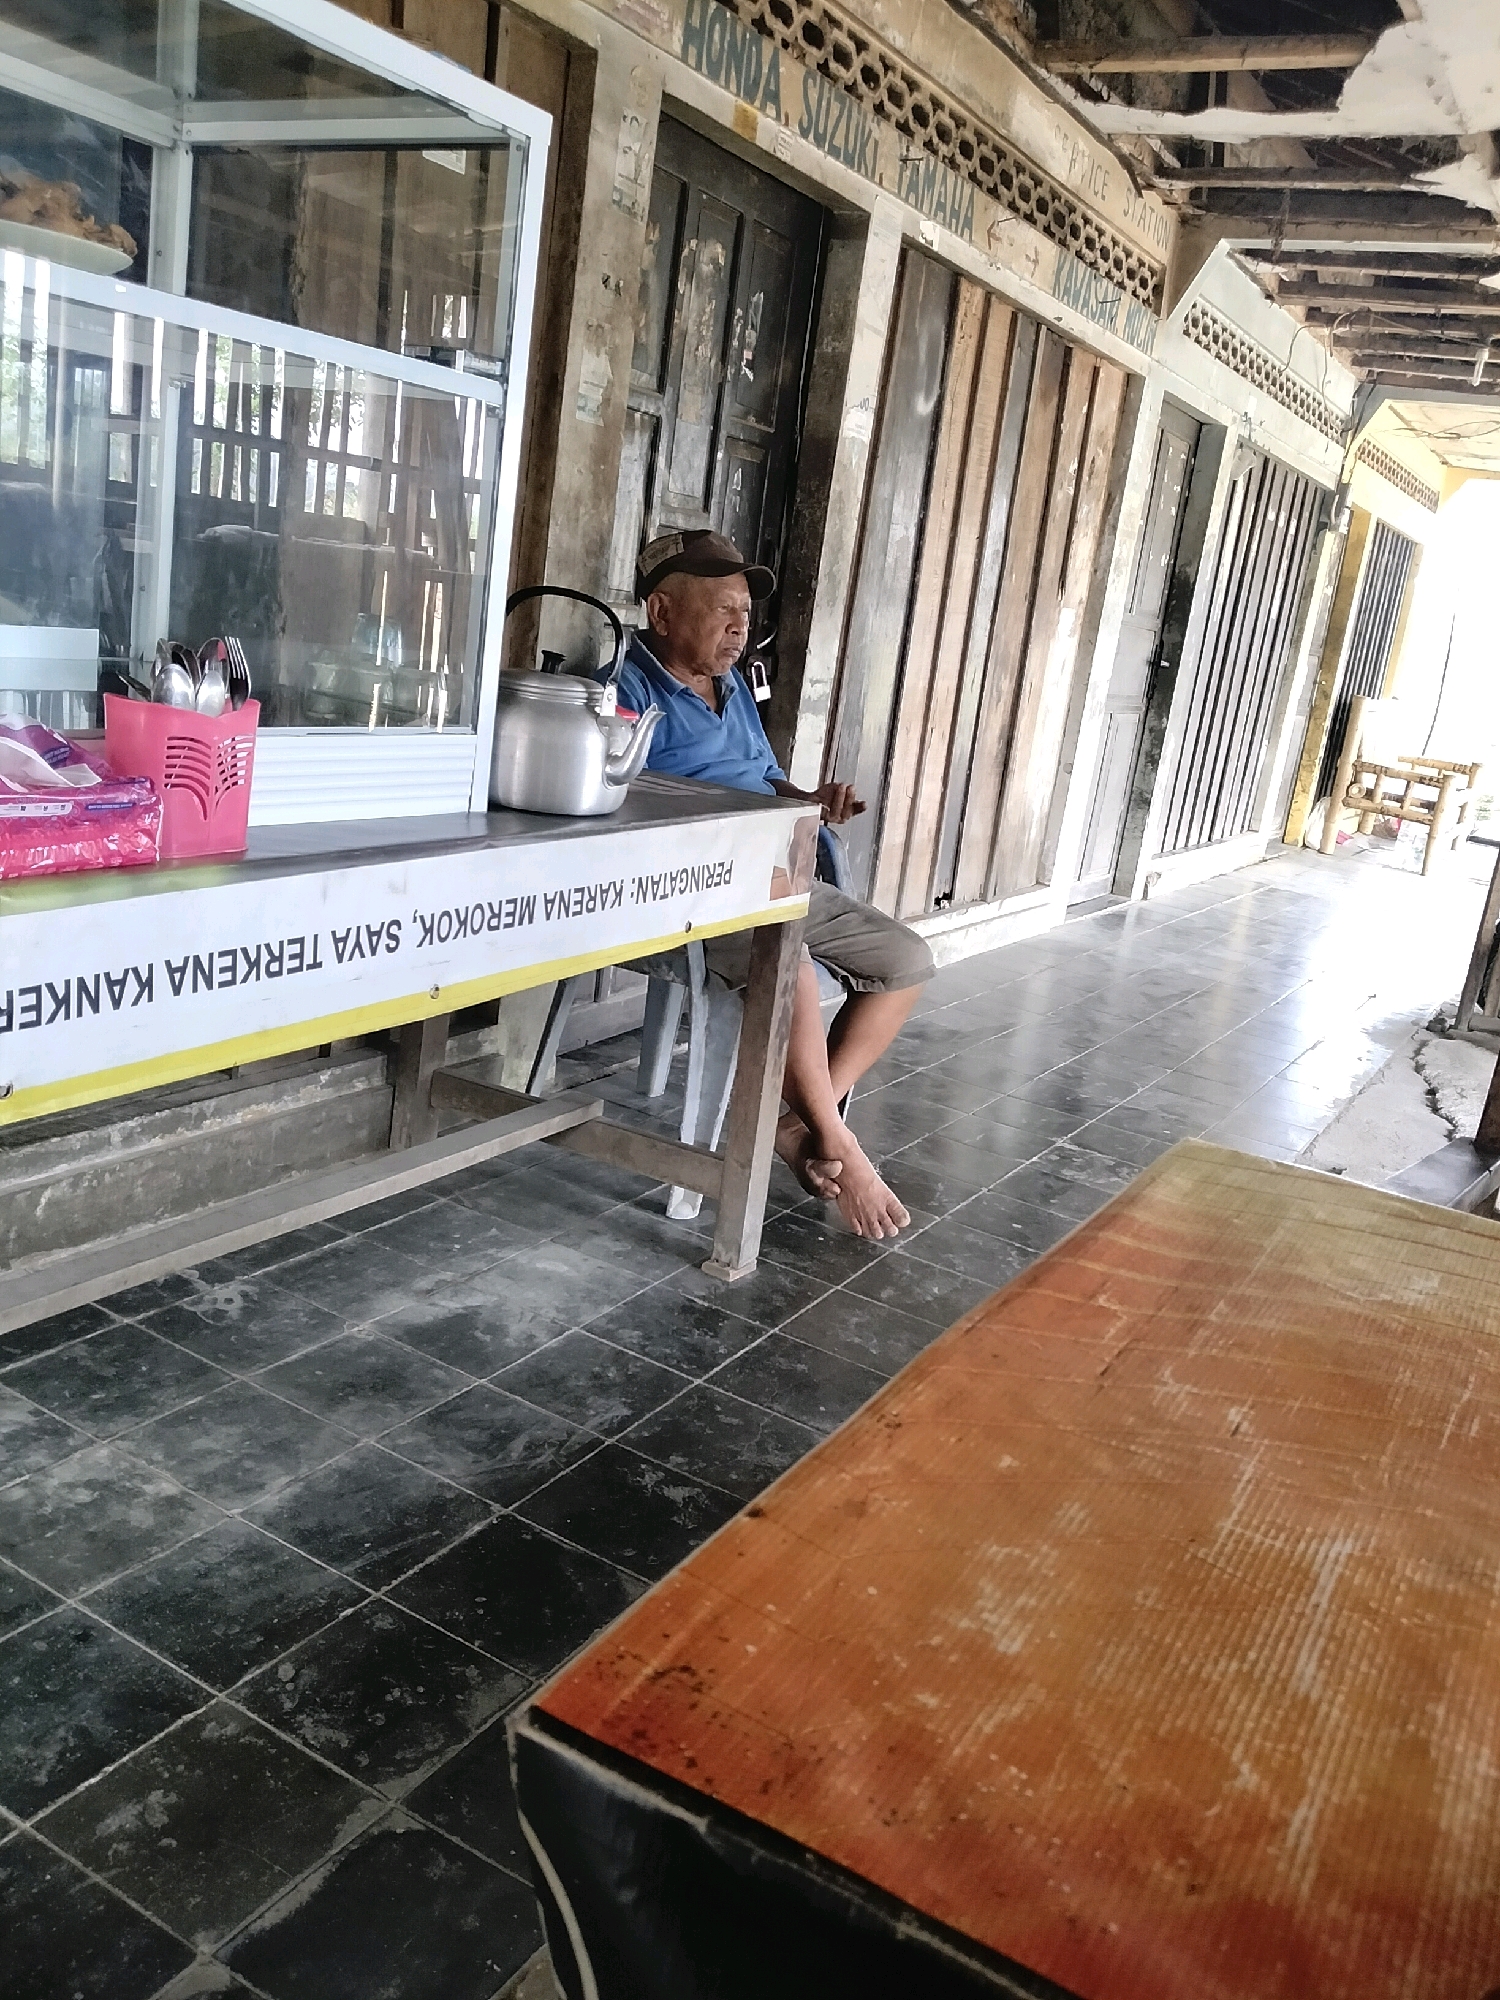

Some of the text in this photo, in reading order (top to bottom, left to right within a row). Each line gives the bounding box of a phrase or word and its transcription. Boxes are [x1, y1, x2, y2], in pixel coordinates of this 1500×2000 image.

[897, 132, 975, 246] YAMAHA
[1123, 187, 1171, 250] STATION
[543, 879, 625, 921] KARENA
[630, 859, 734, 905] PERINGATAN:
[330, 919, 402, 964] SAYA
[412, 894, 537, 948] MEROKOK,
[164, 933, 323, 997] TERKENA
